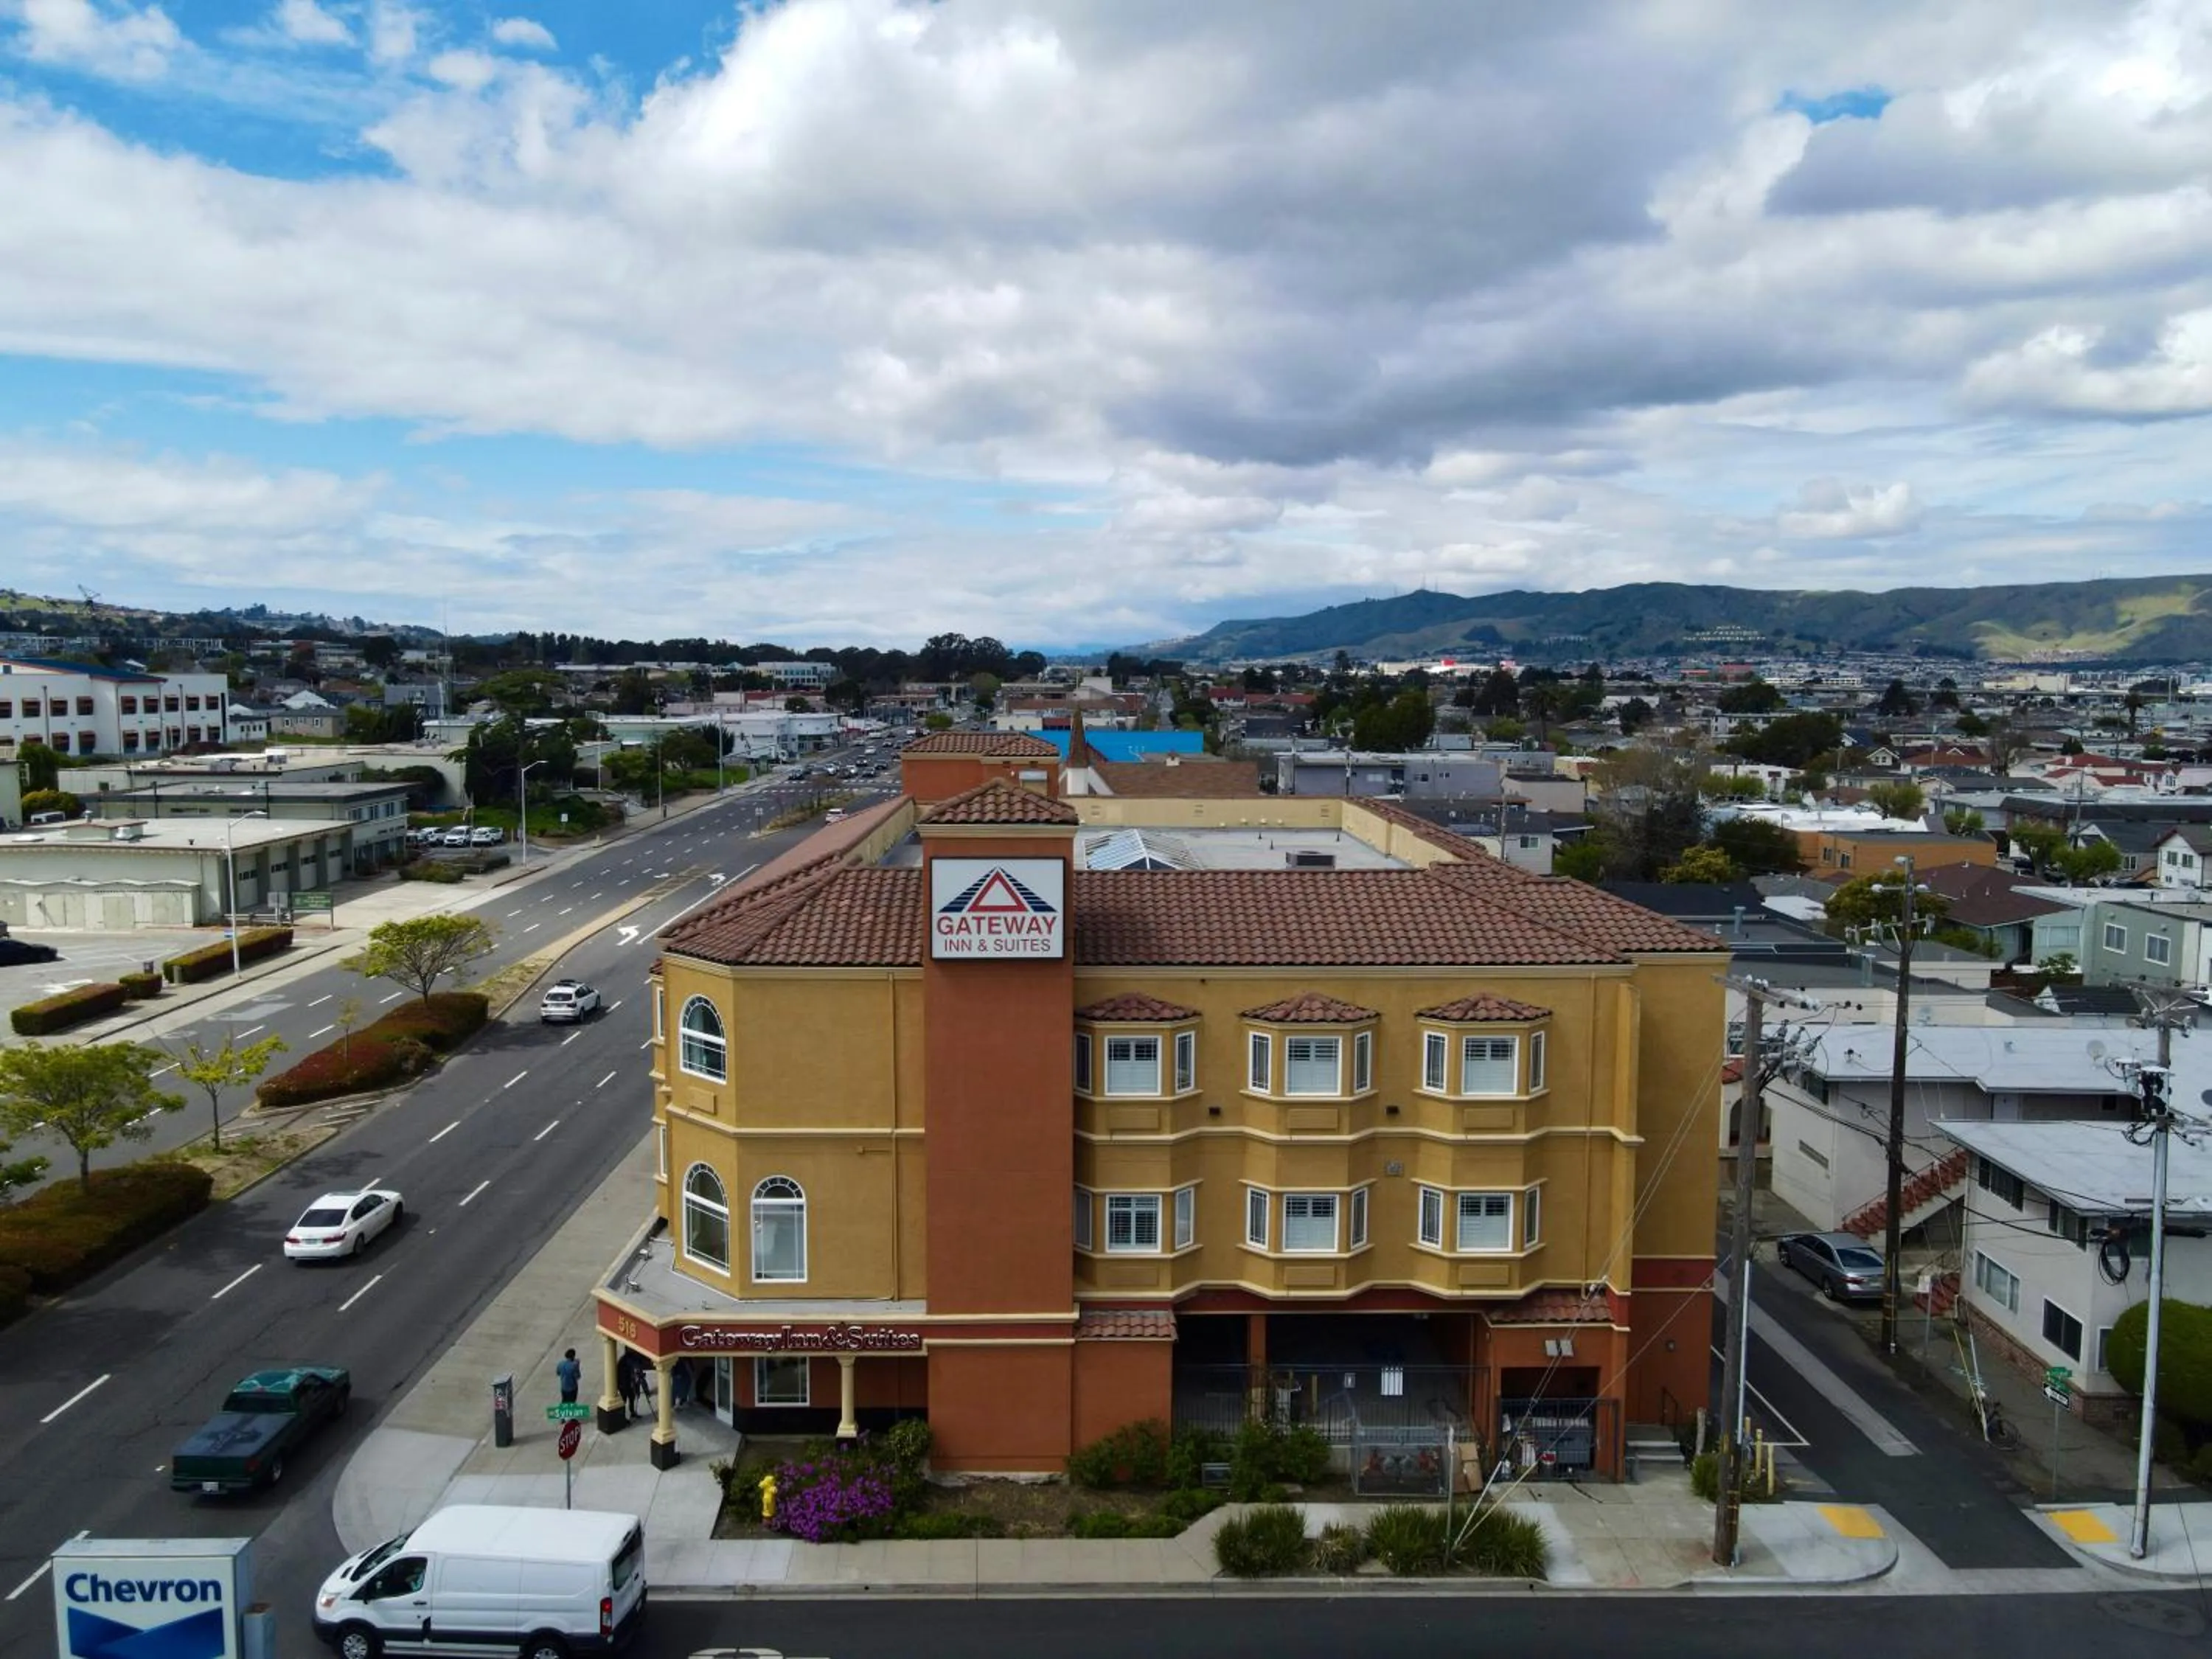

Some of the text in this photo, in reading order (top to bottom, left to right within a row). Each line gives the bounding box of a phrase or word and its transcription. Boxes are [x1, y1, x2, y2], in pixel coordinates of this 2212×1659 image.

[936, 916, 1057, 936] GATEWAY
[944, 939, 1051, 952] INN & SUITES
[680, 1325, 920, 1352] Gateway Inn & Suites
[560, 1426, 581, 1453] STOP
[65, 1573, 221, 1603] Chevron
